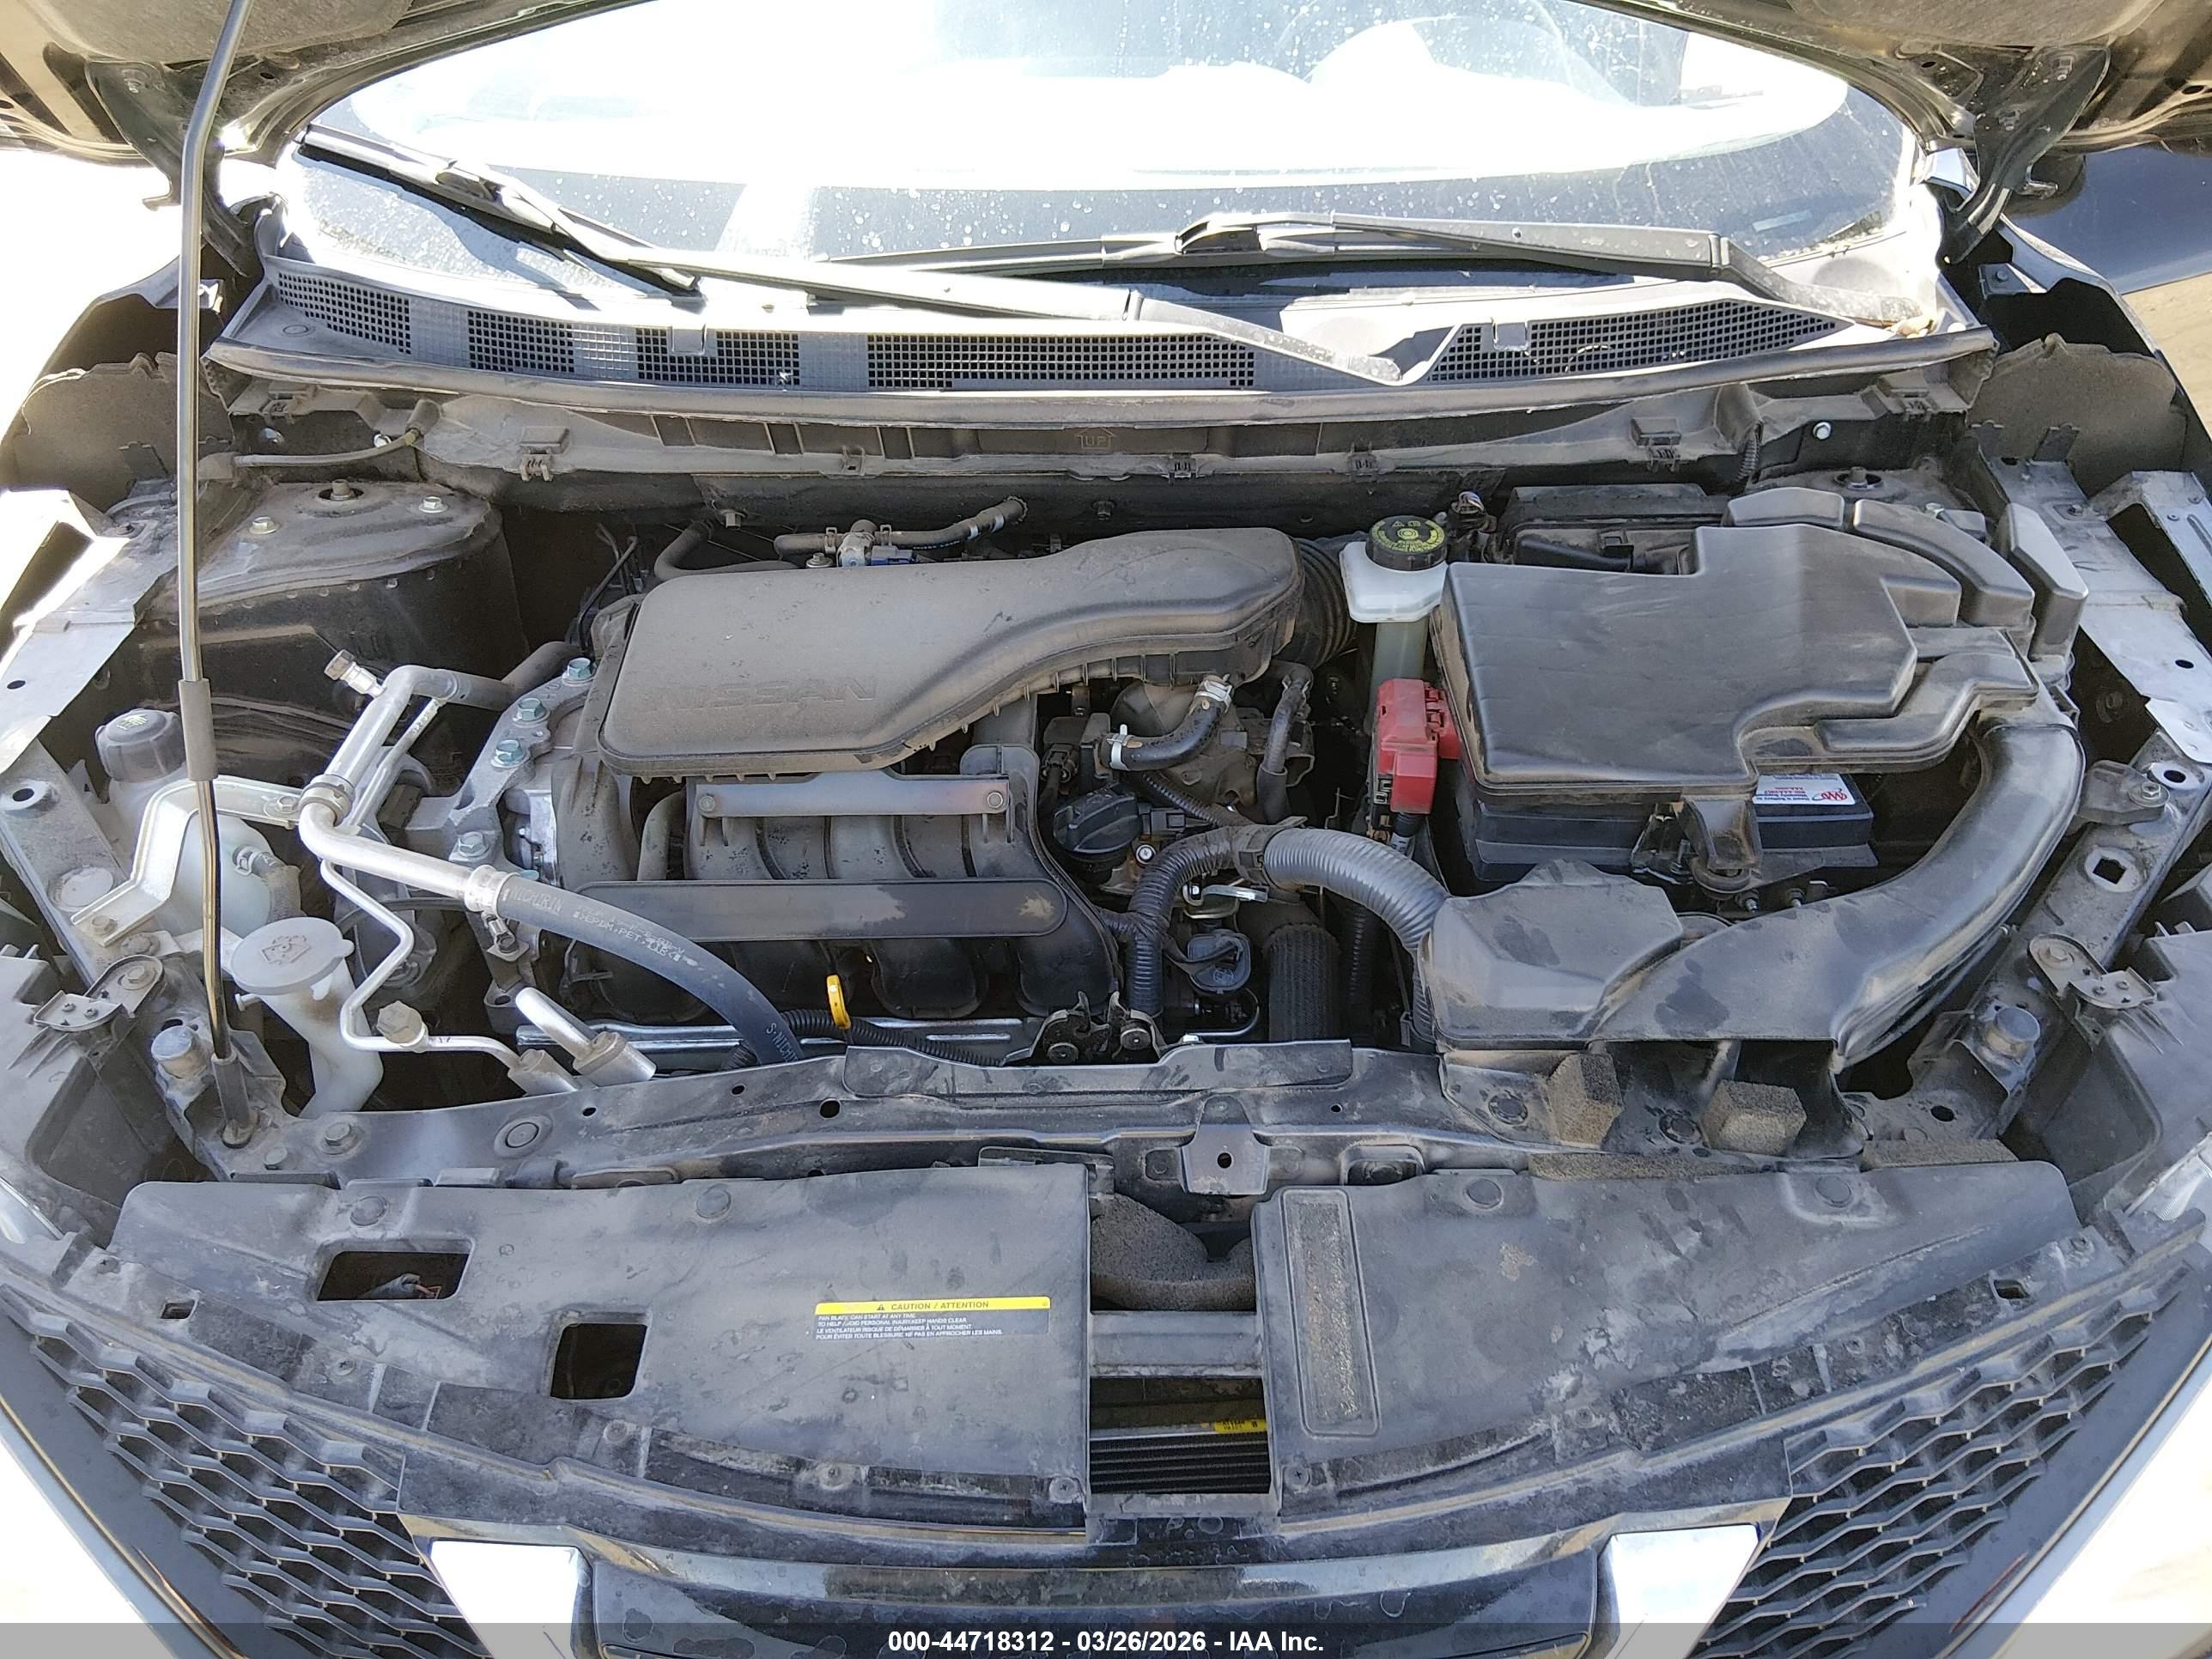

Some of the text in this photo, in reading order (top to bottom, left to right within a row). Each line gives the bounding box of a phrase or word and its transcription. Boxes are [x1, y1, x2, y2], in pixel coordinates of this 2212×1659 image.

[1085, 435, 1108, 447] UP
[655, 678, 876, 711] NISSAN
[940, 1300, 989, 1309] ATTENTION
